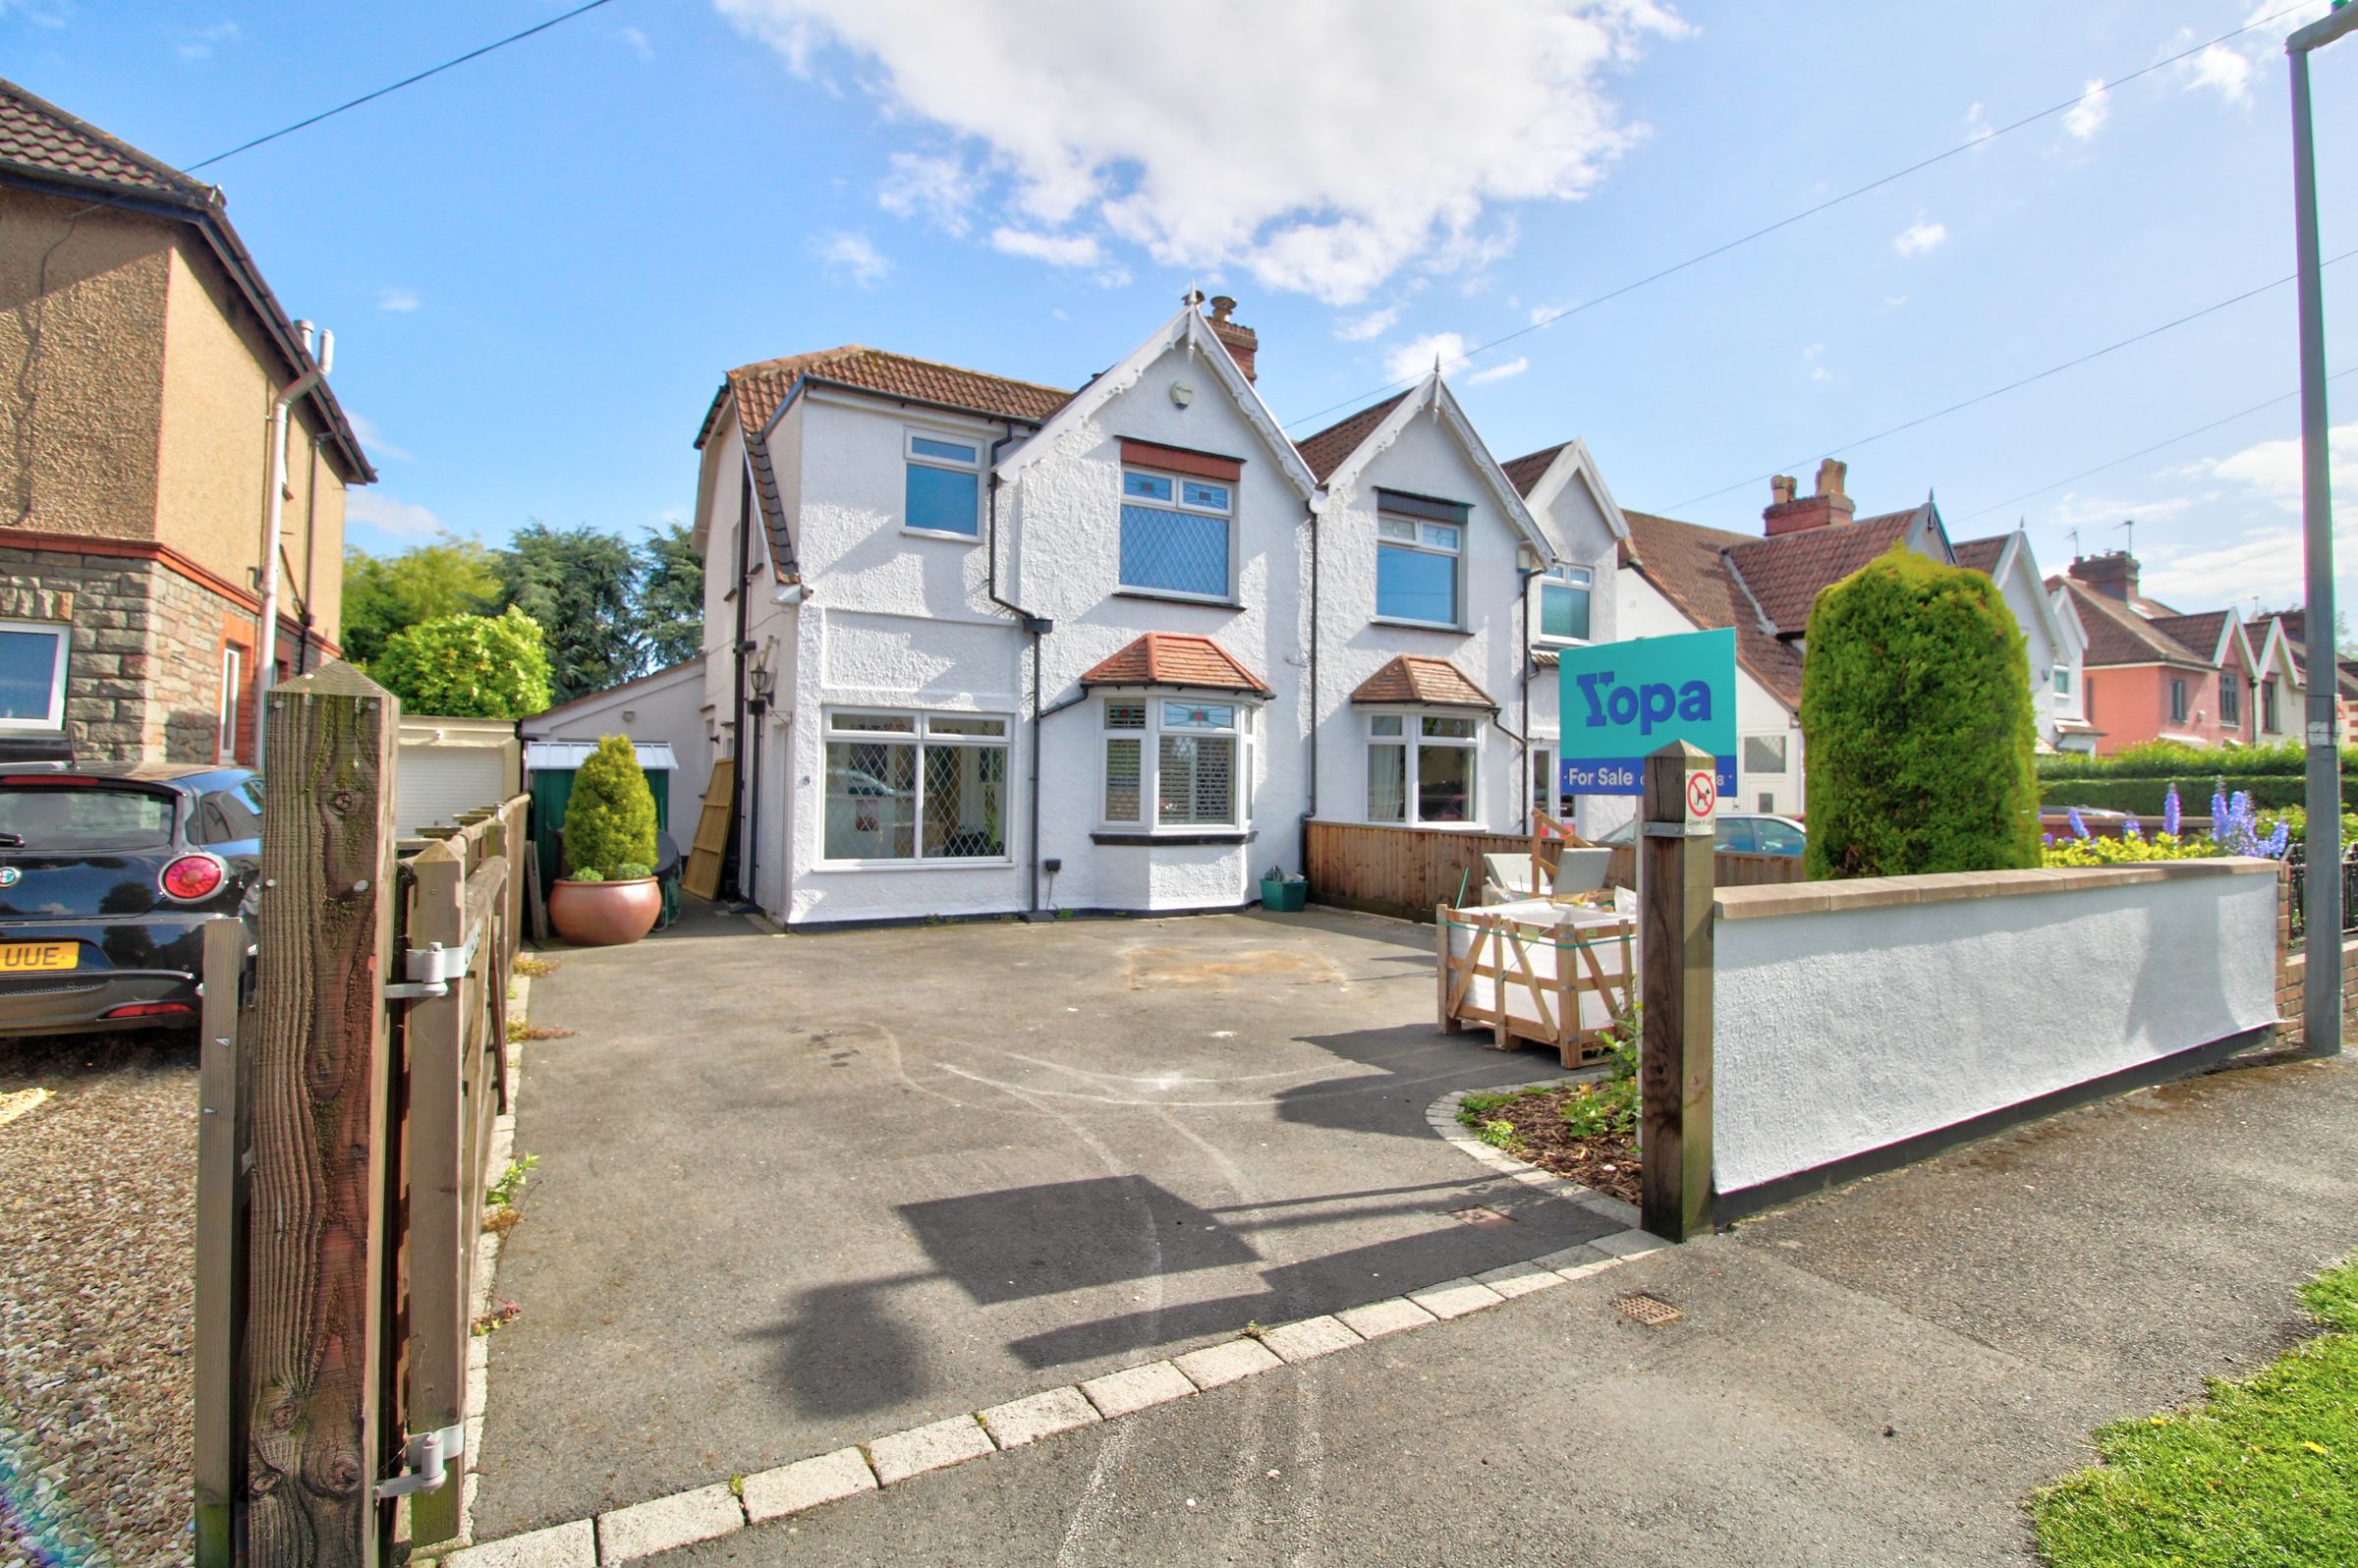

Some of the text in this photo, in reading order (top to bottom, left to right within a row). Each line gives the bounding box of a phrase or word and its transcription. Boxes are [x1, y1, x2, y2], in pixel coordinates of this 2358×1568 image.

[1576, 671, 1712, 736] Yopa
[1568, 767, 1594, 786] For
[1598, 766, 1633, 786] Sale
[5, 946, 60, 967] UUE
